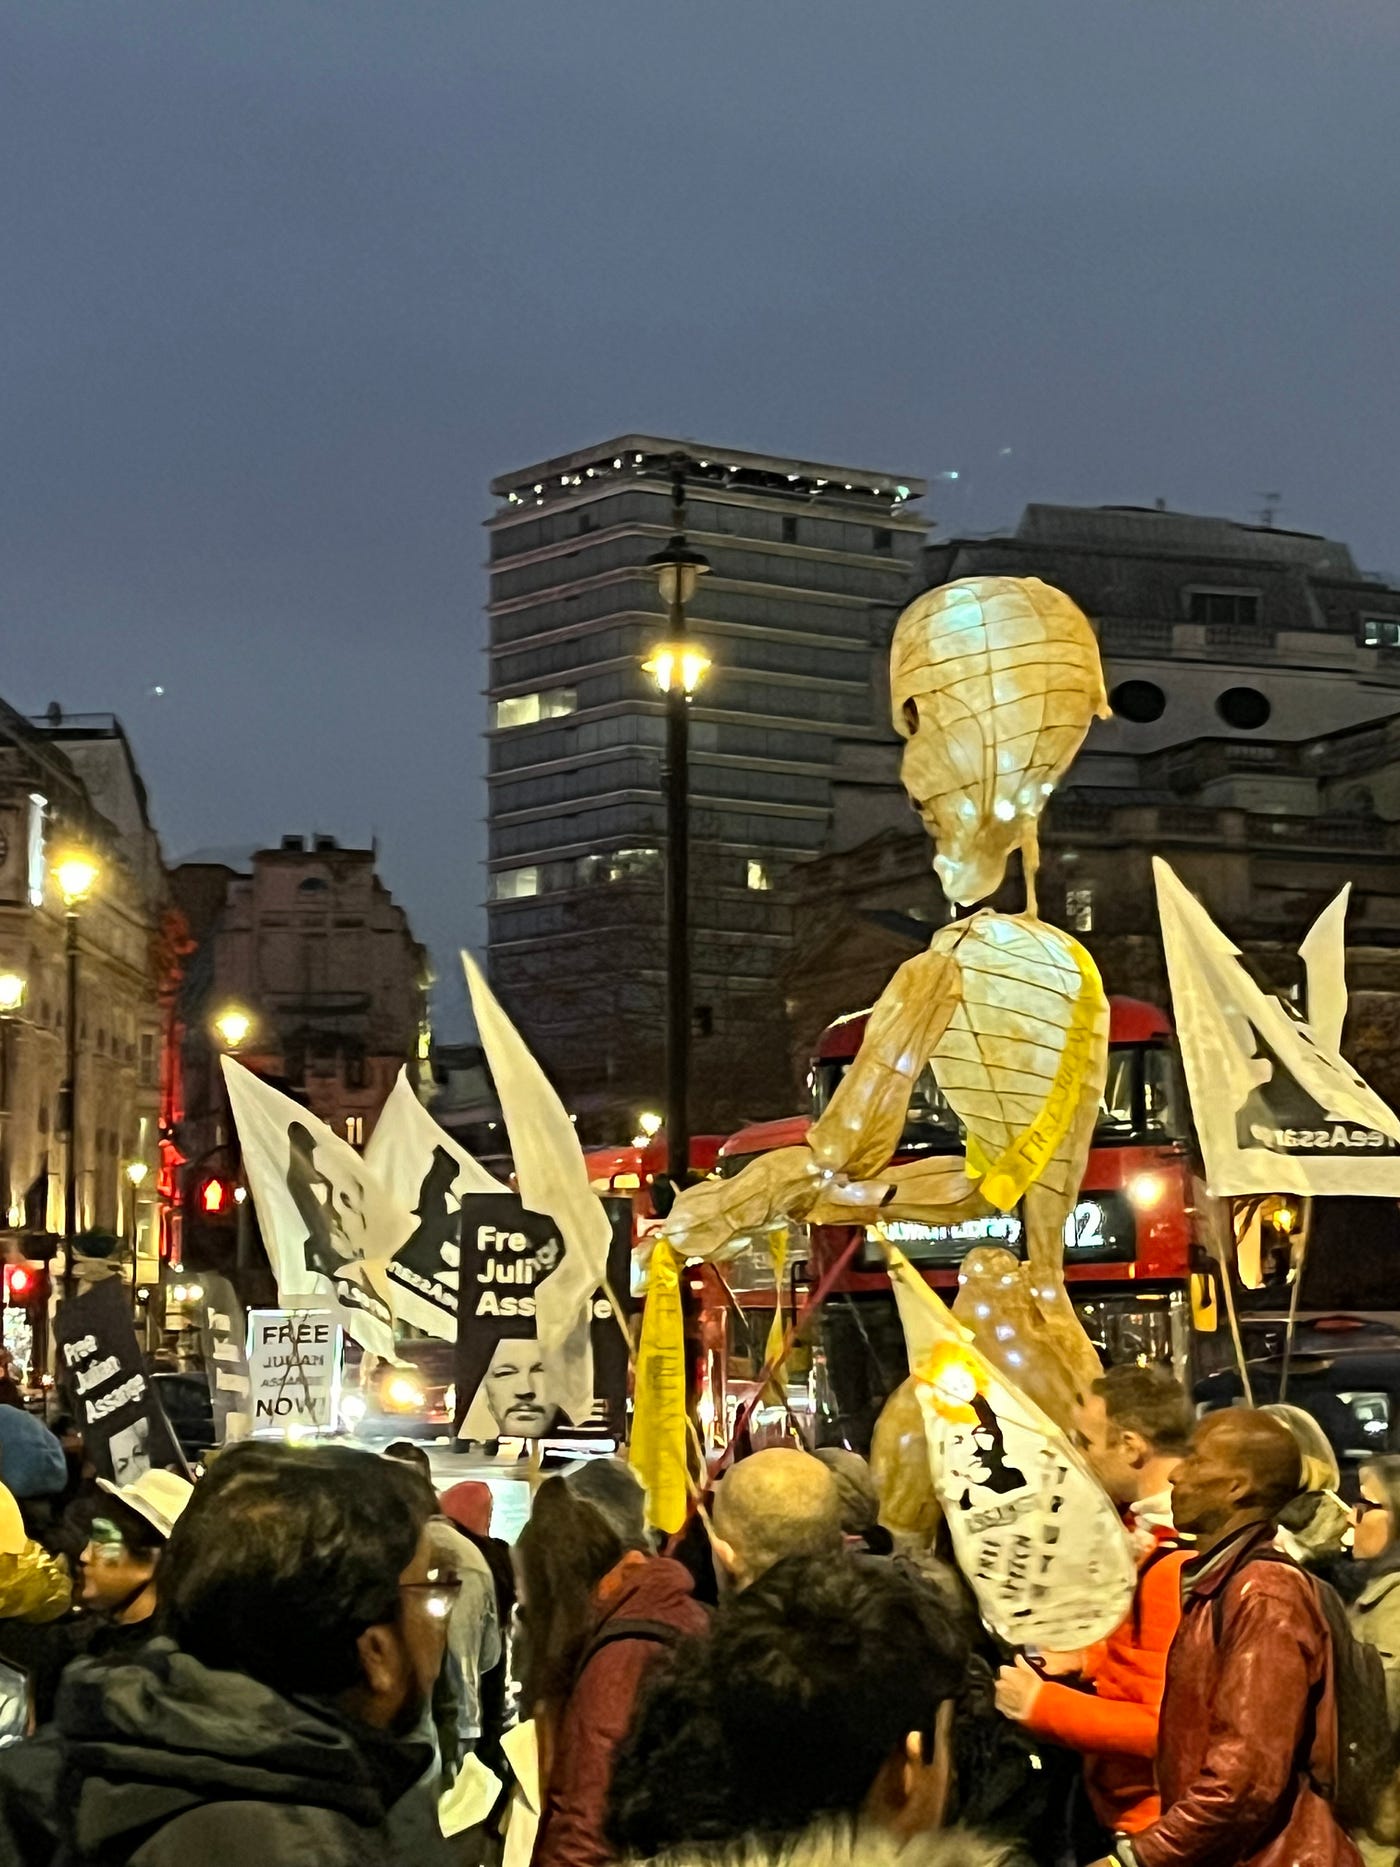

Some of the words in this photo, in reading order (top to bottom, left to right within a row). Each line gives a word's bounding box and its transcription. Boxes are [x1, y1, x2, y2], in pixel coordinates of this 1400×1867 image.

[477, 1225, 528, 1252] Fre
[476, 1257, 534, 1285] Juli
[475, 1290, 613, 1320] Asse
[262, 1323, 329, 1345] FREE
